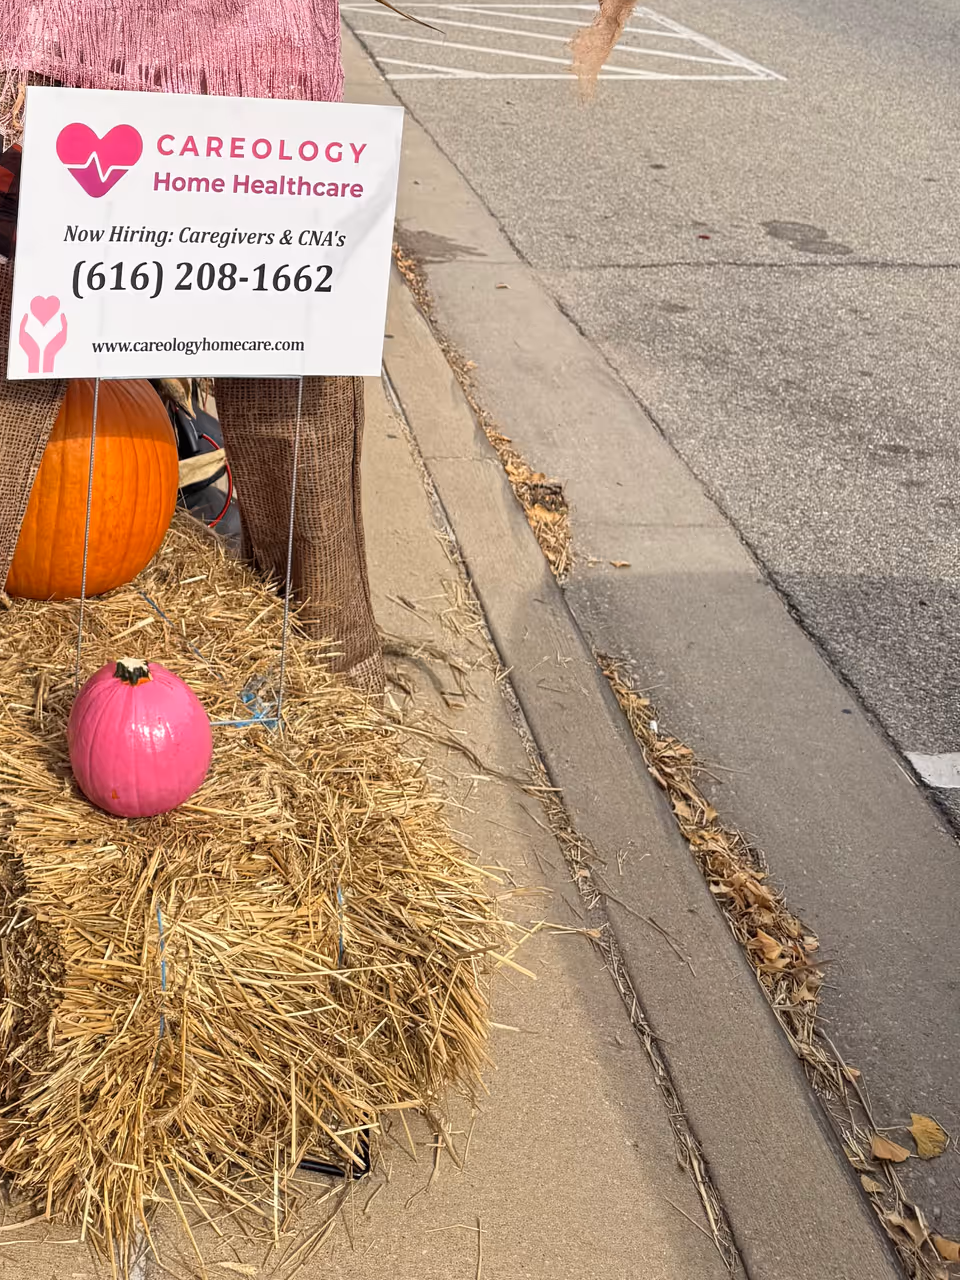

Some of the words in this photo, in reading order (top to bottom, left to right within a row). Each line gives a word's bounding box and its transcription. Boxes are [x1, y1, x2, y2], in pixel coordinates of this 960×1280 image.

[156, 133, 368, 164] CAREOLOGY
[153, 171, 226, 193] Home
[232, 174, 364, 198] Healthcare
[63, 225, 104, 243] Now
[109, 225, 174, 248] Hiring:
[178, 226, 274, 249] Caregivers
[279, 229, 293, 245] &
[298, 229, 346, 247] CNA's
[72, 260, 164, 299] (616)
[174, 261, 334, 293] 208-1662
[91, 337, 305, 356] www.careologyhomecare.com
